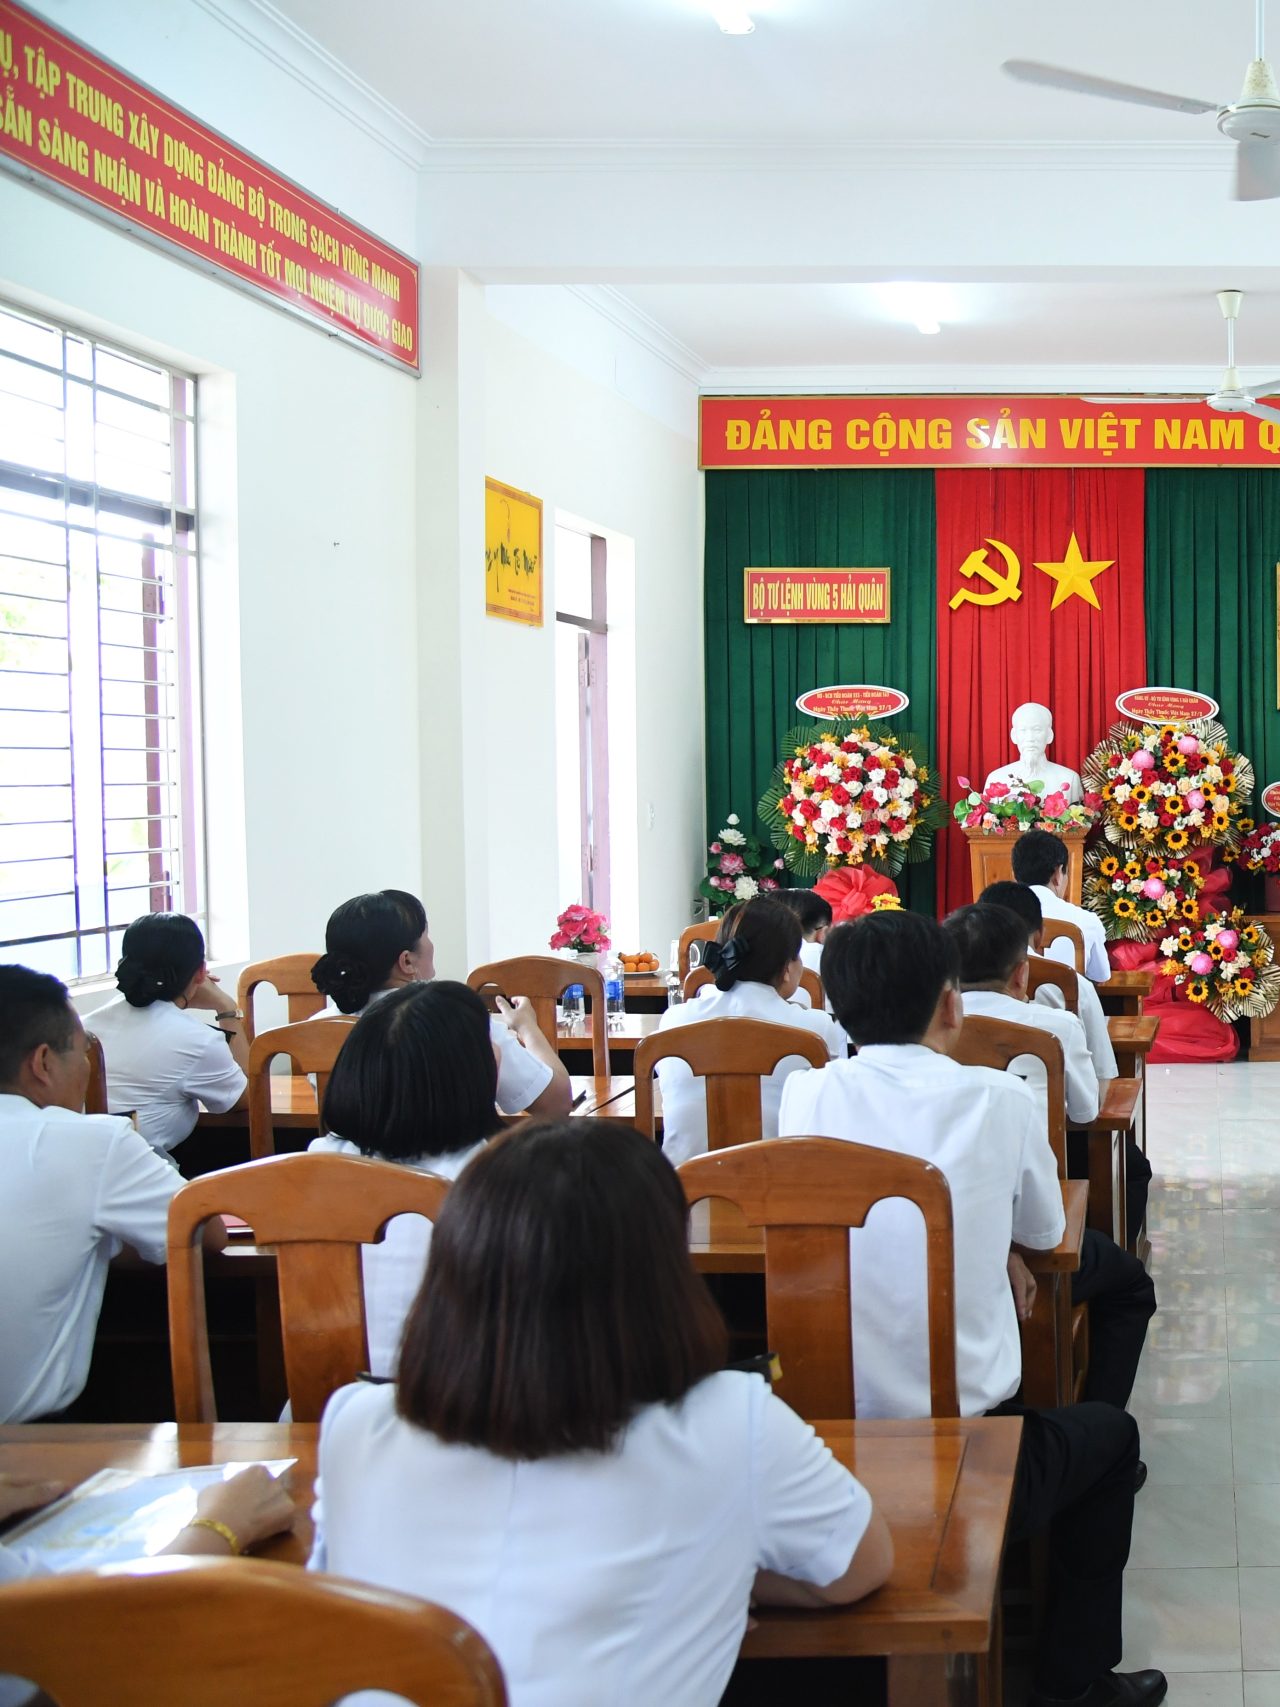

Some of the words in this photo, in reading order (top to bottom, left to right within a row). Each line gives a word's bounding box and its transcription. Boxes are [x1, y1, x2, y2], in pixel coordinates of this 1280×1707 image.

[0, 84, 33, 147] ẴN
[38, 117, 89, 177] SÀNG
[94, 149, 141, 206] NHẬN
[145, 178, 165, 220] VÀ
[169, 191, 209, 244] HOÀN
[213, 218, 257, 269] THÀNH
[259, 239, 282, 281] TỐT
[284, 257, 307, 299] MỌI
[309, 271, 346, 316] NHIỆM
[349, 293, 361, 330] VỤ
[363, 303, 389, 342] ĐƯỢC
[391, 318, 413, 352] GIAO
[24, 46, 61, 99] TẬP
[66, 72, 124, 138] TRUNG
[128, 111, 159, 158] XÂY
[163, 133, 204, 187] DỰNG
[207, 158, 245, 211] ĐẢNG
[248, 187, 265, 228] BỘ
[268, 199, 308, 247] TRONG
[310, 225, 340, 266] SẠCH
[342, 242, 369, 284] VỮNG
[371, 262, 400, 302] MẠNH
[725, 409, 832, 450] ĐẢNG
[846, 412, 952, 457] CỘNG
[966, 408, 1046, 450] SẢN
[1059, 411, 1141, 456] VIỆT
[1154, 419, 1244, 450] NAM
[752, 577, 765, 616] BỘ
[767, 580, 780, 610] TƯ
[781, 577, 803, 616] LỆNH
[806, 577, 830, 610] VÙNG
[832, 583, 838, 610] 5
[841, 573, 856, 610] HẢI
[858, 577, 883, 613] QUÂN
